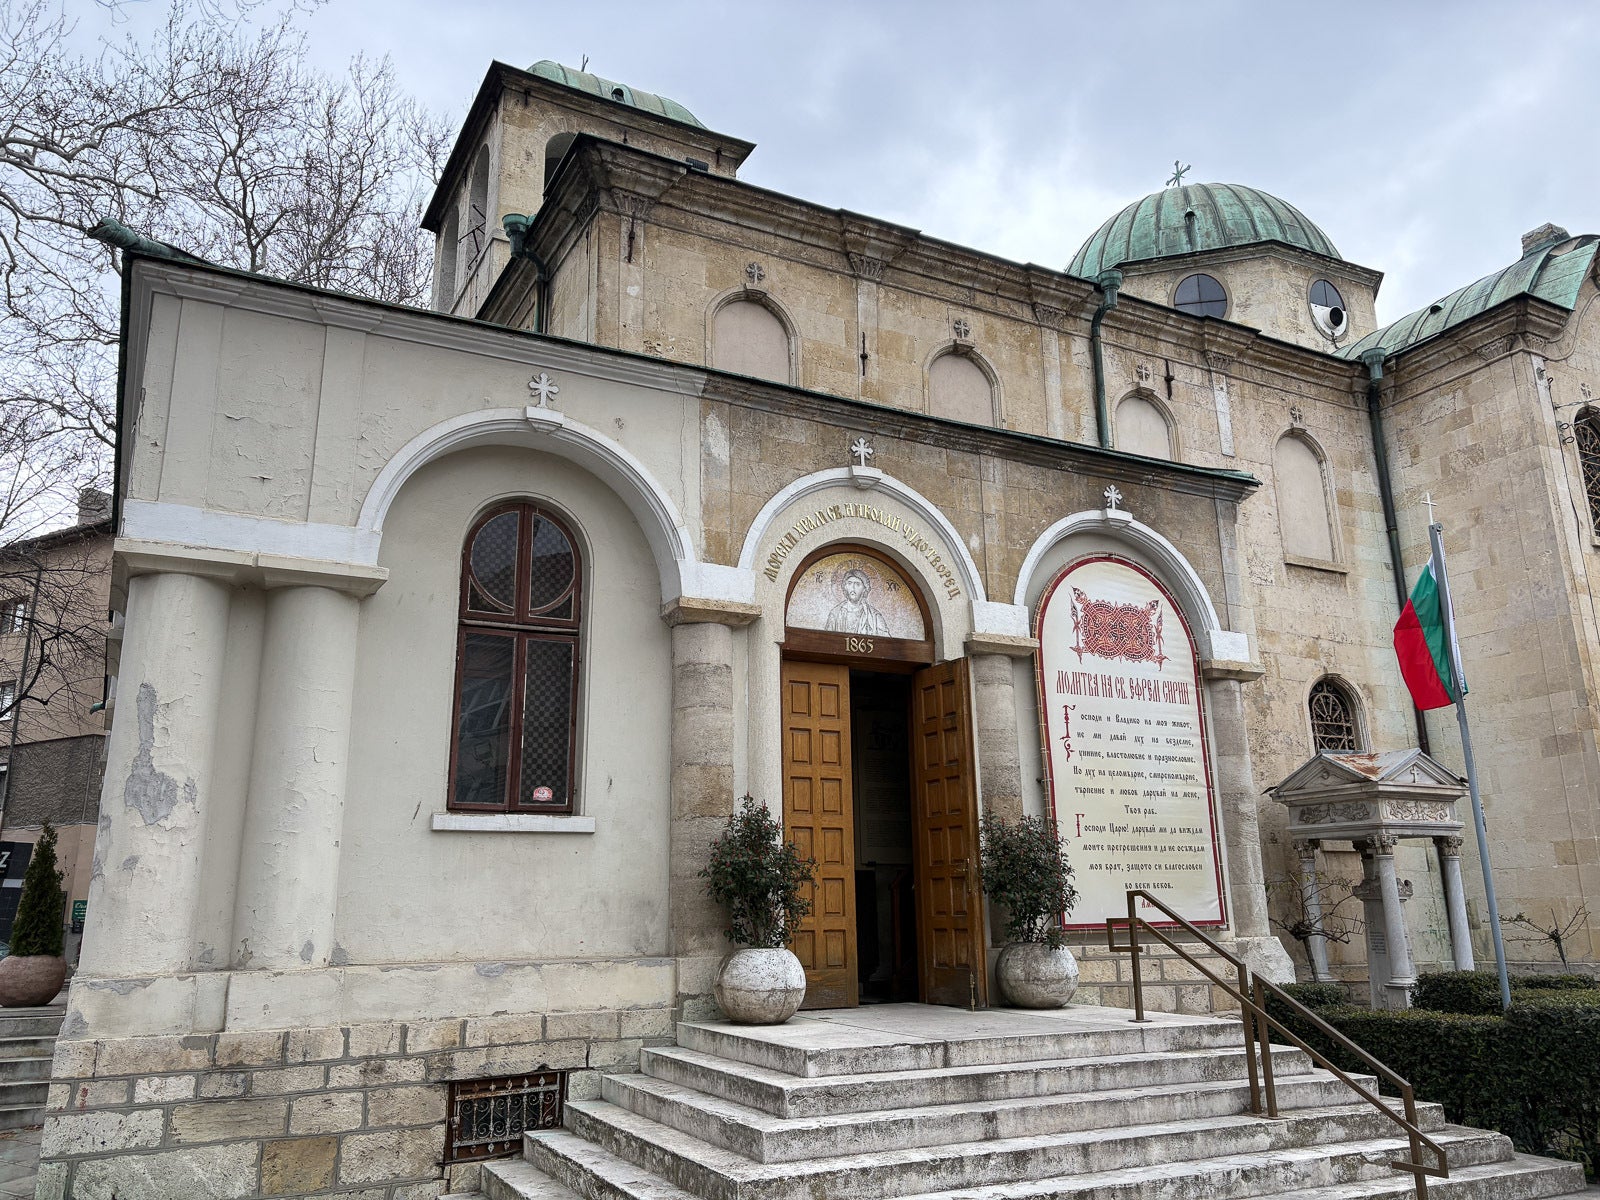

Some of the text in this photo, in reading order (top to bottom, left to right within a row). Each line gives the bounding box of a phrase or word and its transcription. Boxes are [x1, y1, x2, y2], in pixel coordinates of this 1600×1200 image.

[844, 502, 901, 533] НИКОЛАЙ
[844, 637, 874, 654] 1865
[1056, 670, 1099, 697] МОЛИТВА
[1101, 674, 1113, 698] НА
[1129, 677, 1161, 703] ЕФРЕМ
[1170, 827, 1177, 835] да
[1160, 845, 1167, 853] да
[1089, 863, 1103, 871] моя
[1154, 863, 1162, 871] си
